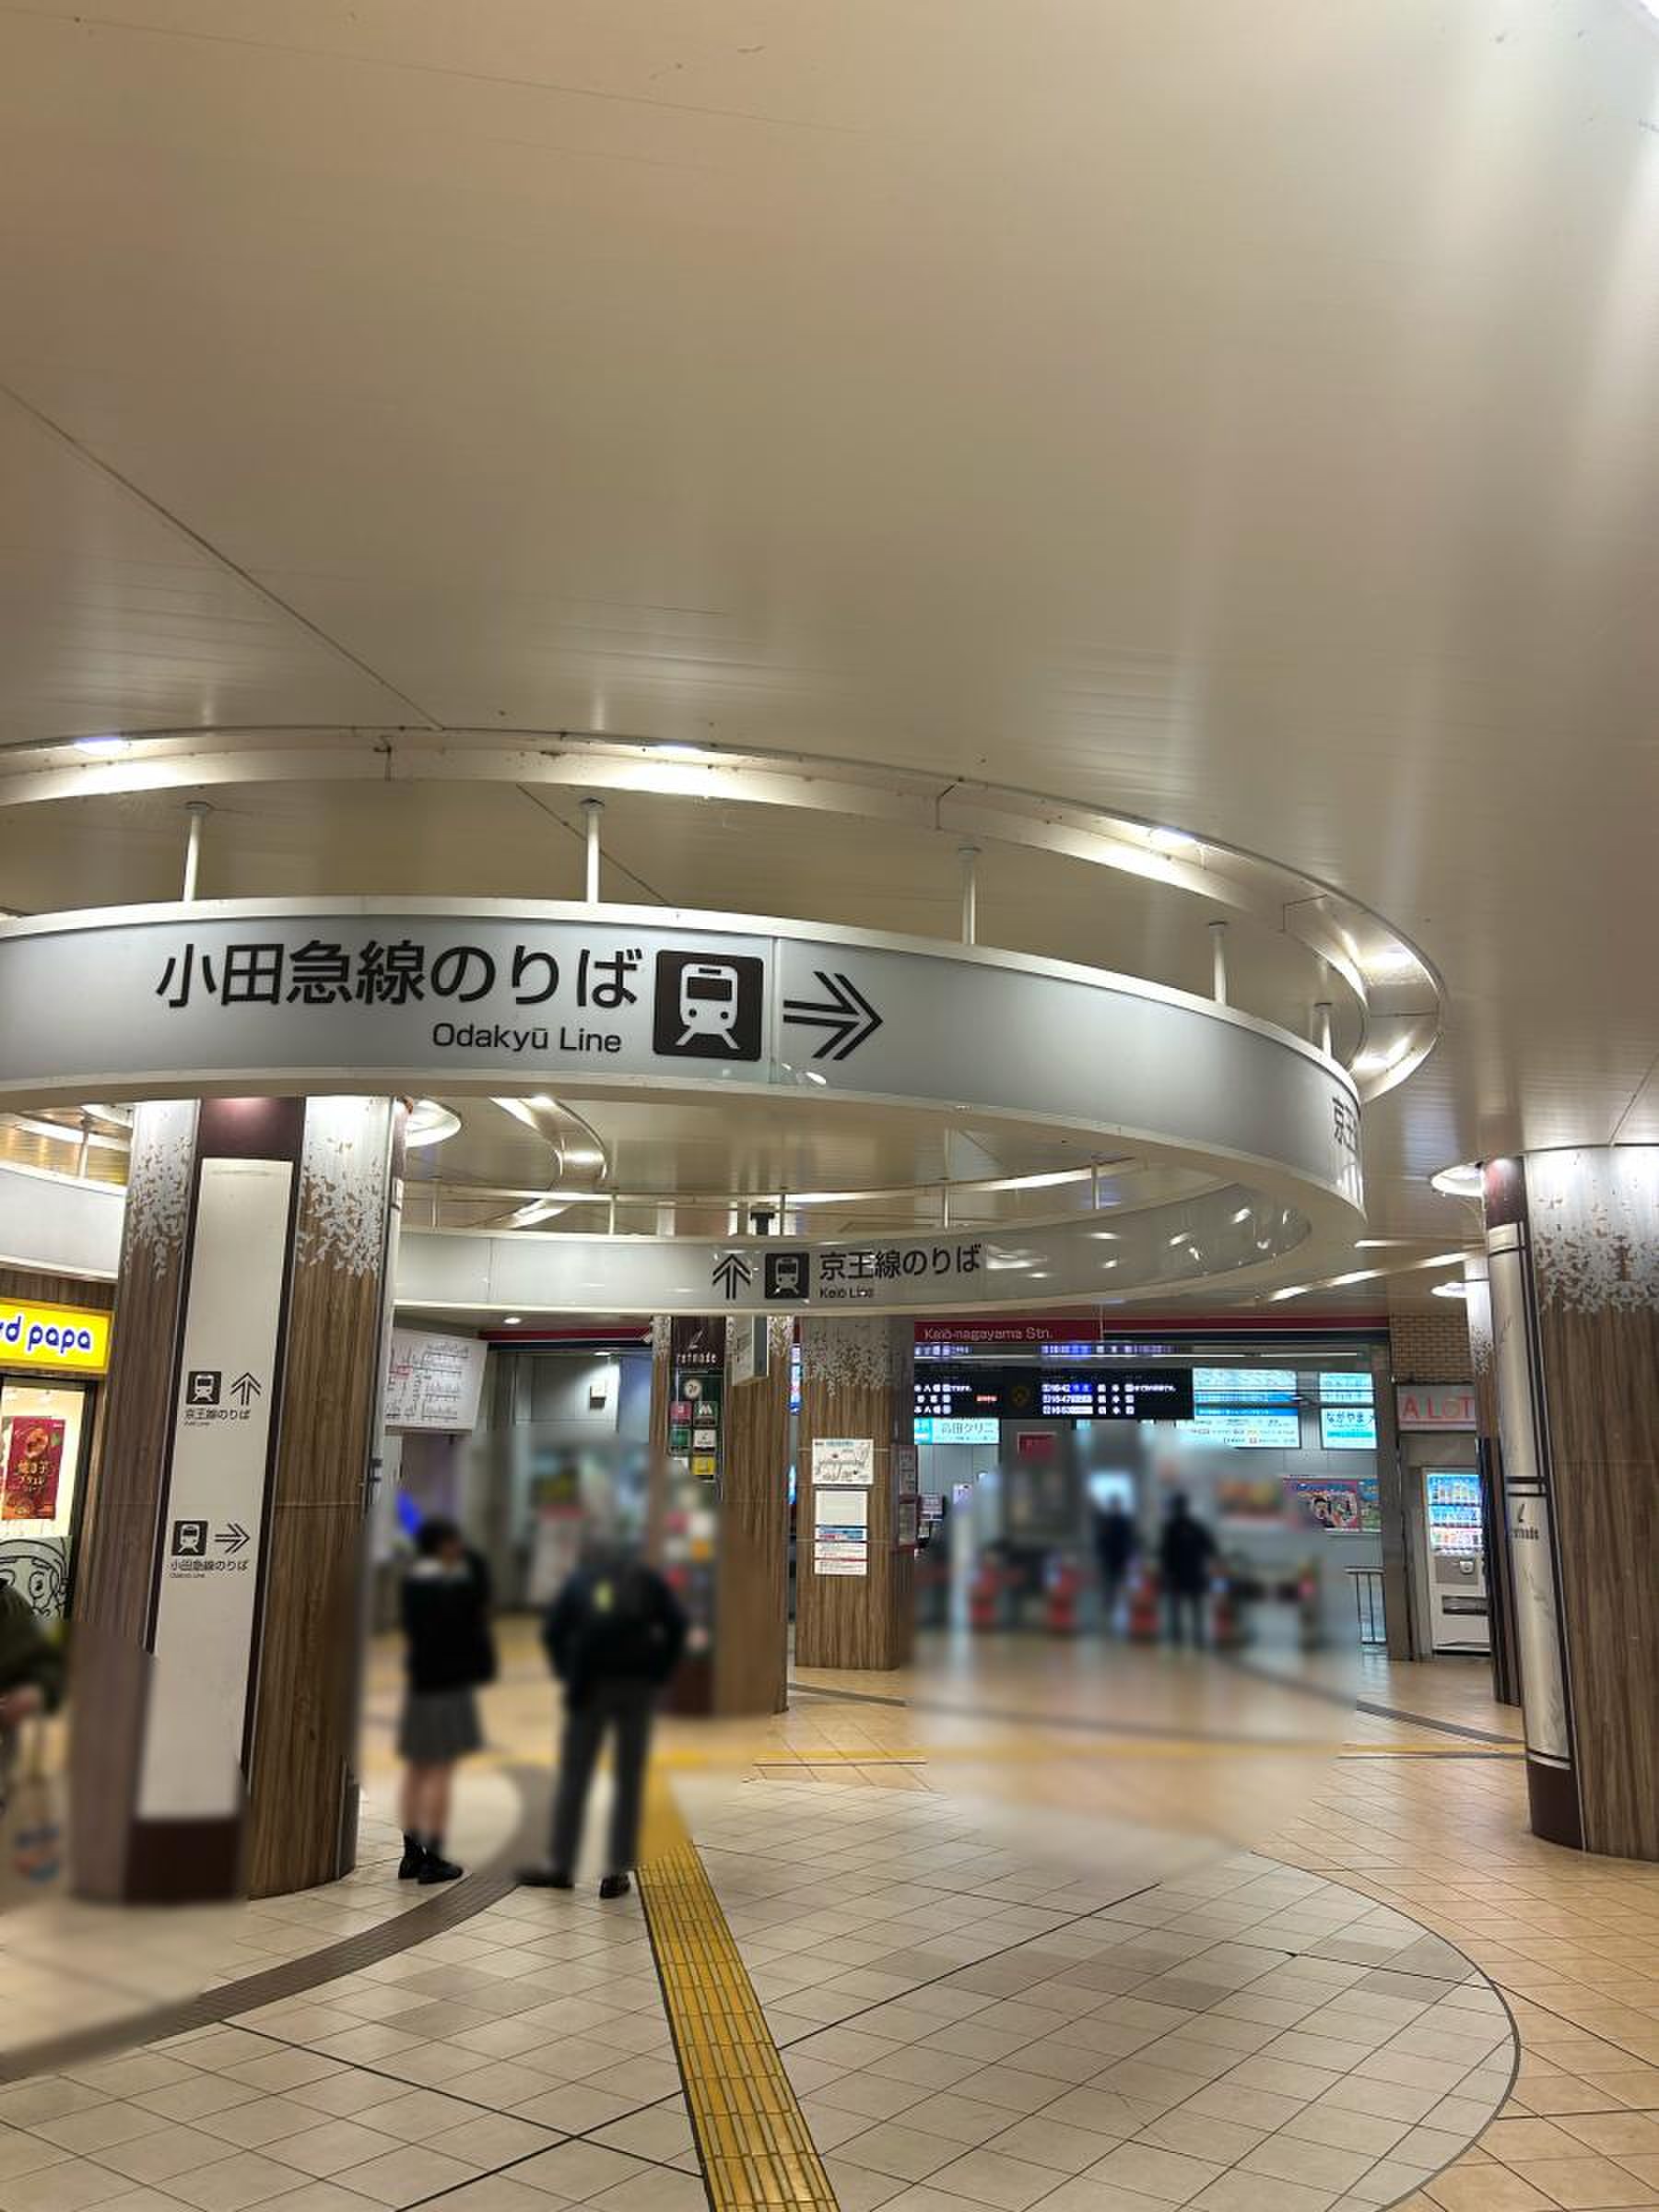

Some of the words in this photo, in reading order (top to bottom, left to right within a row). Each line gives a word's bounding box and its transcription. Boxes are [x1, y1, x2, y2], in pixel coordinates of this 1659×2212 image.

[156, 939, 642, 1008] 小田急線のりば
[432, 1022, 548, 1052] Odakyū
[559, 1027, 622, 1053] Line
[819, 1244, 982, 1280] 京王線のりば
[28, 1325, 90, 1354] papa
